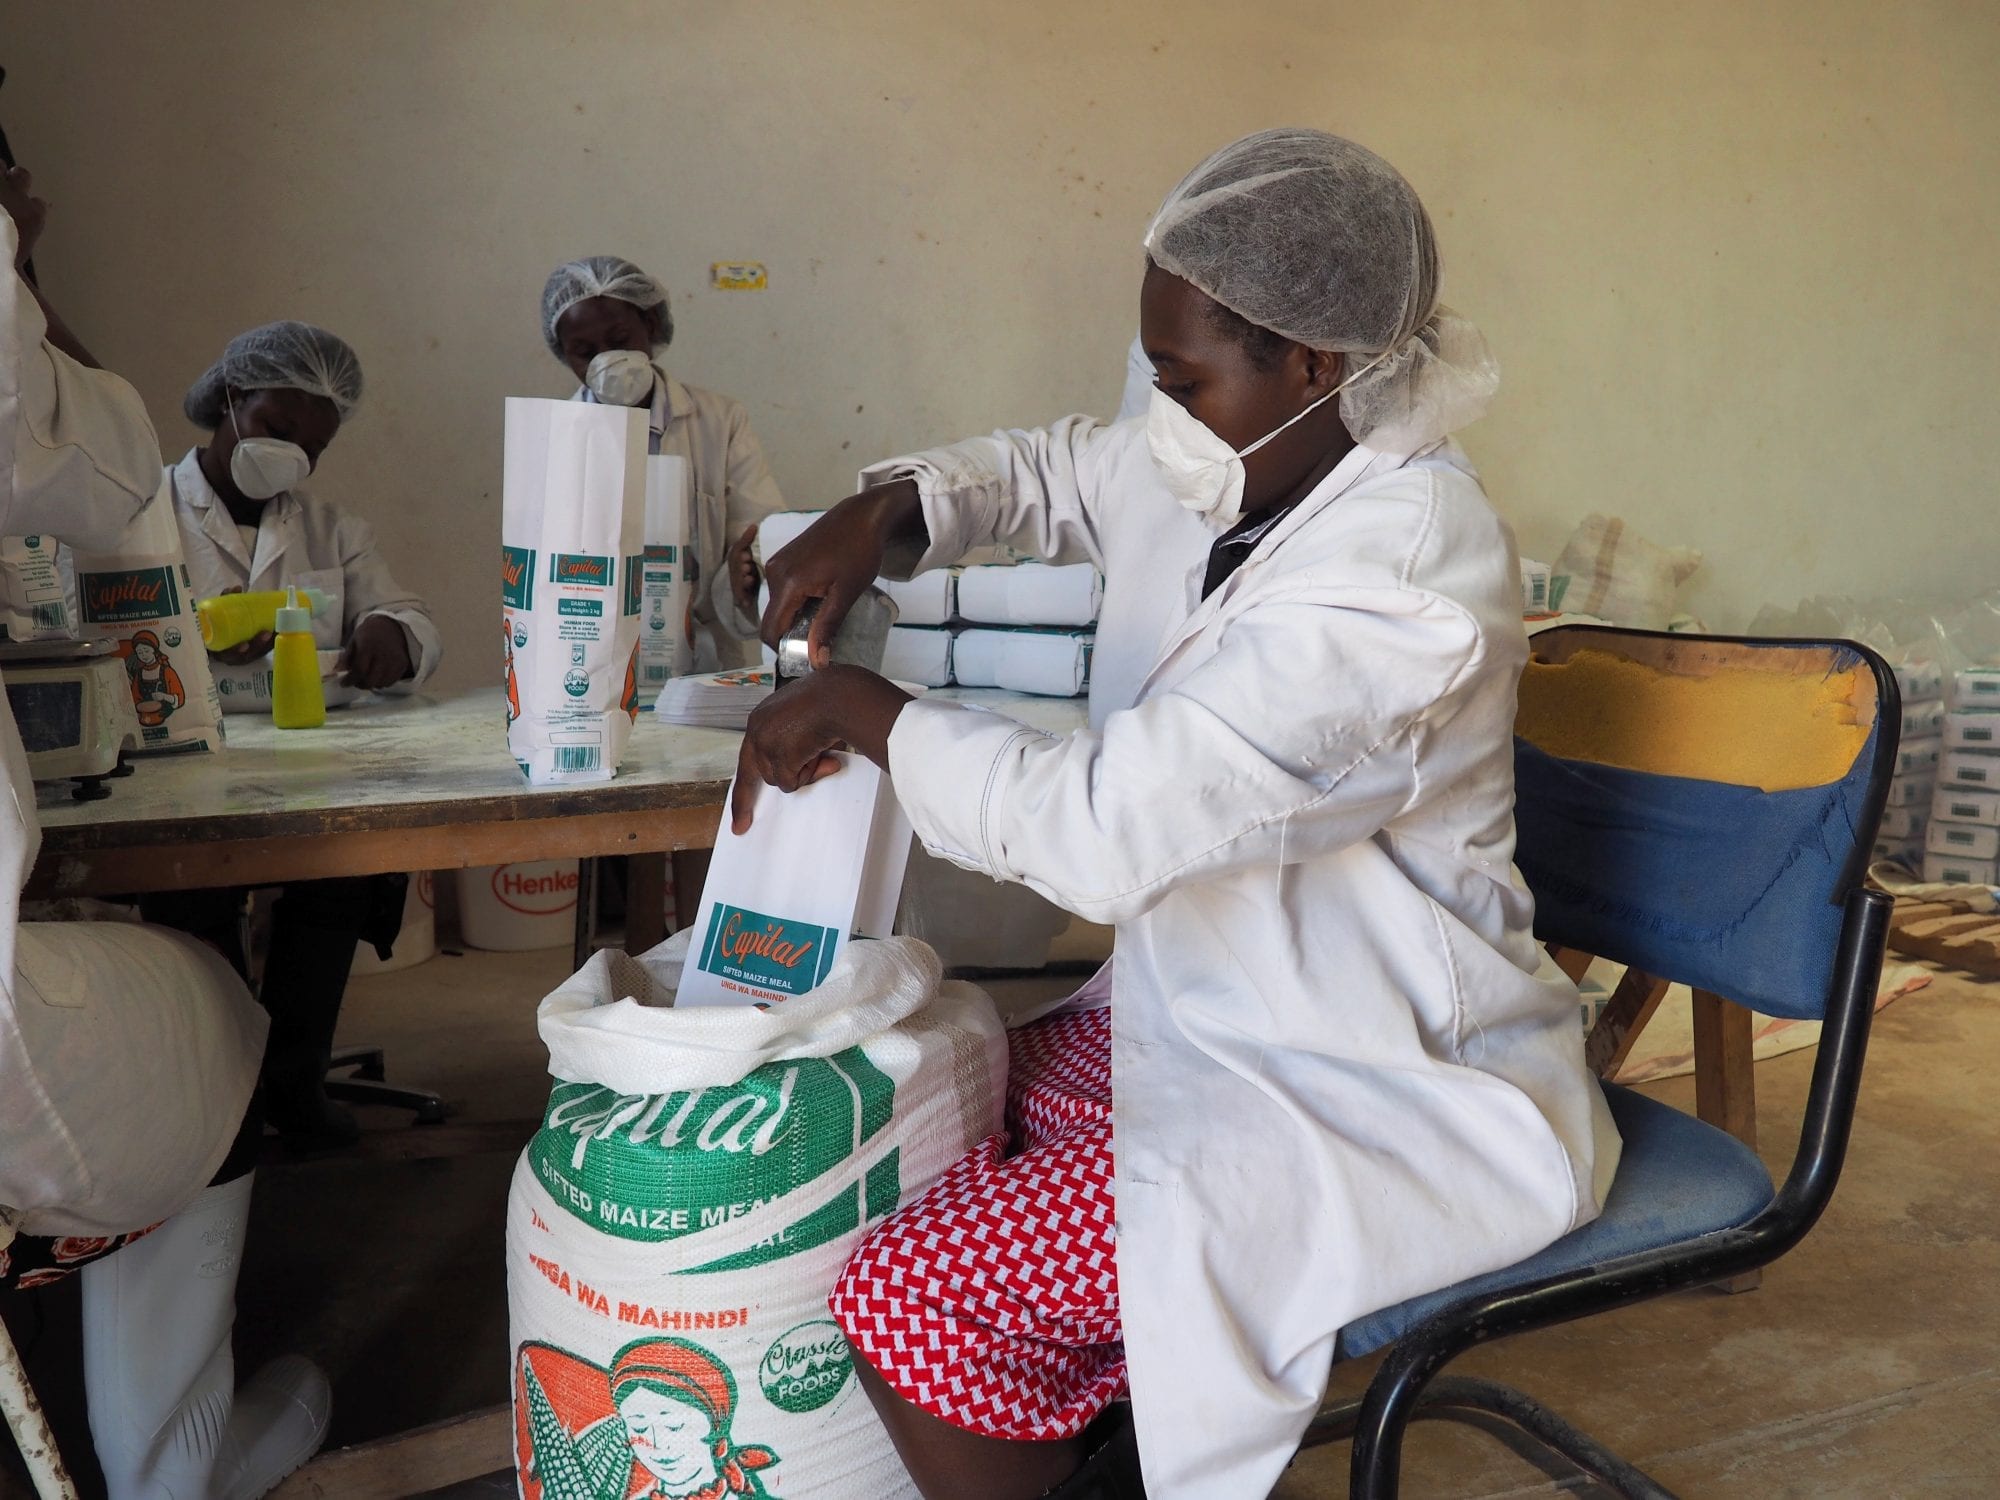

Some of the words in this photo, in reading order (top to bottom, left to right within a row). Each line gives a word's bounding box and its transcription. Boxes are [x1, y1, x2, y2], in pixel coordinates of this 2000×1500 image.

[559, 556, 605, 576] Capital
[88, 575, 162, 610] Capital
[141, 609, 160, 617] MEAL
[720, 911, 813, 969] Capital
[721, 979, 737, 991] UNGA
[737, 984, 749, 995] WA
[722, 965, 743, 978] SIFTED
[743, 971, 767, 984] MAIZE
[768, 977, 793, 990] MEAL
[541, 1157, 593, 1212] SIFTED
[600, 1201, 689, 1231] MAIZE
[576, 1279, 611, 1317] WA
[617, 1300, 749, 1331] MAHINDI
[766, 1332, 848, 1376] Classic
[778, 1366, 841, 1400] FOODS
